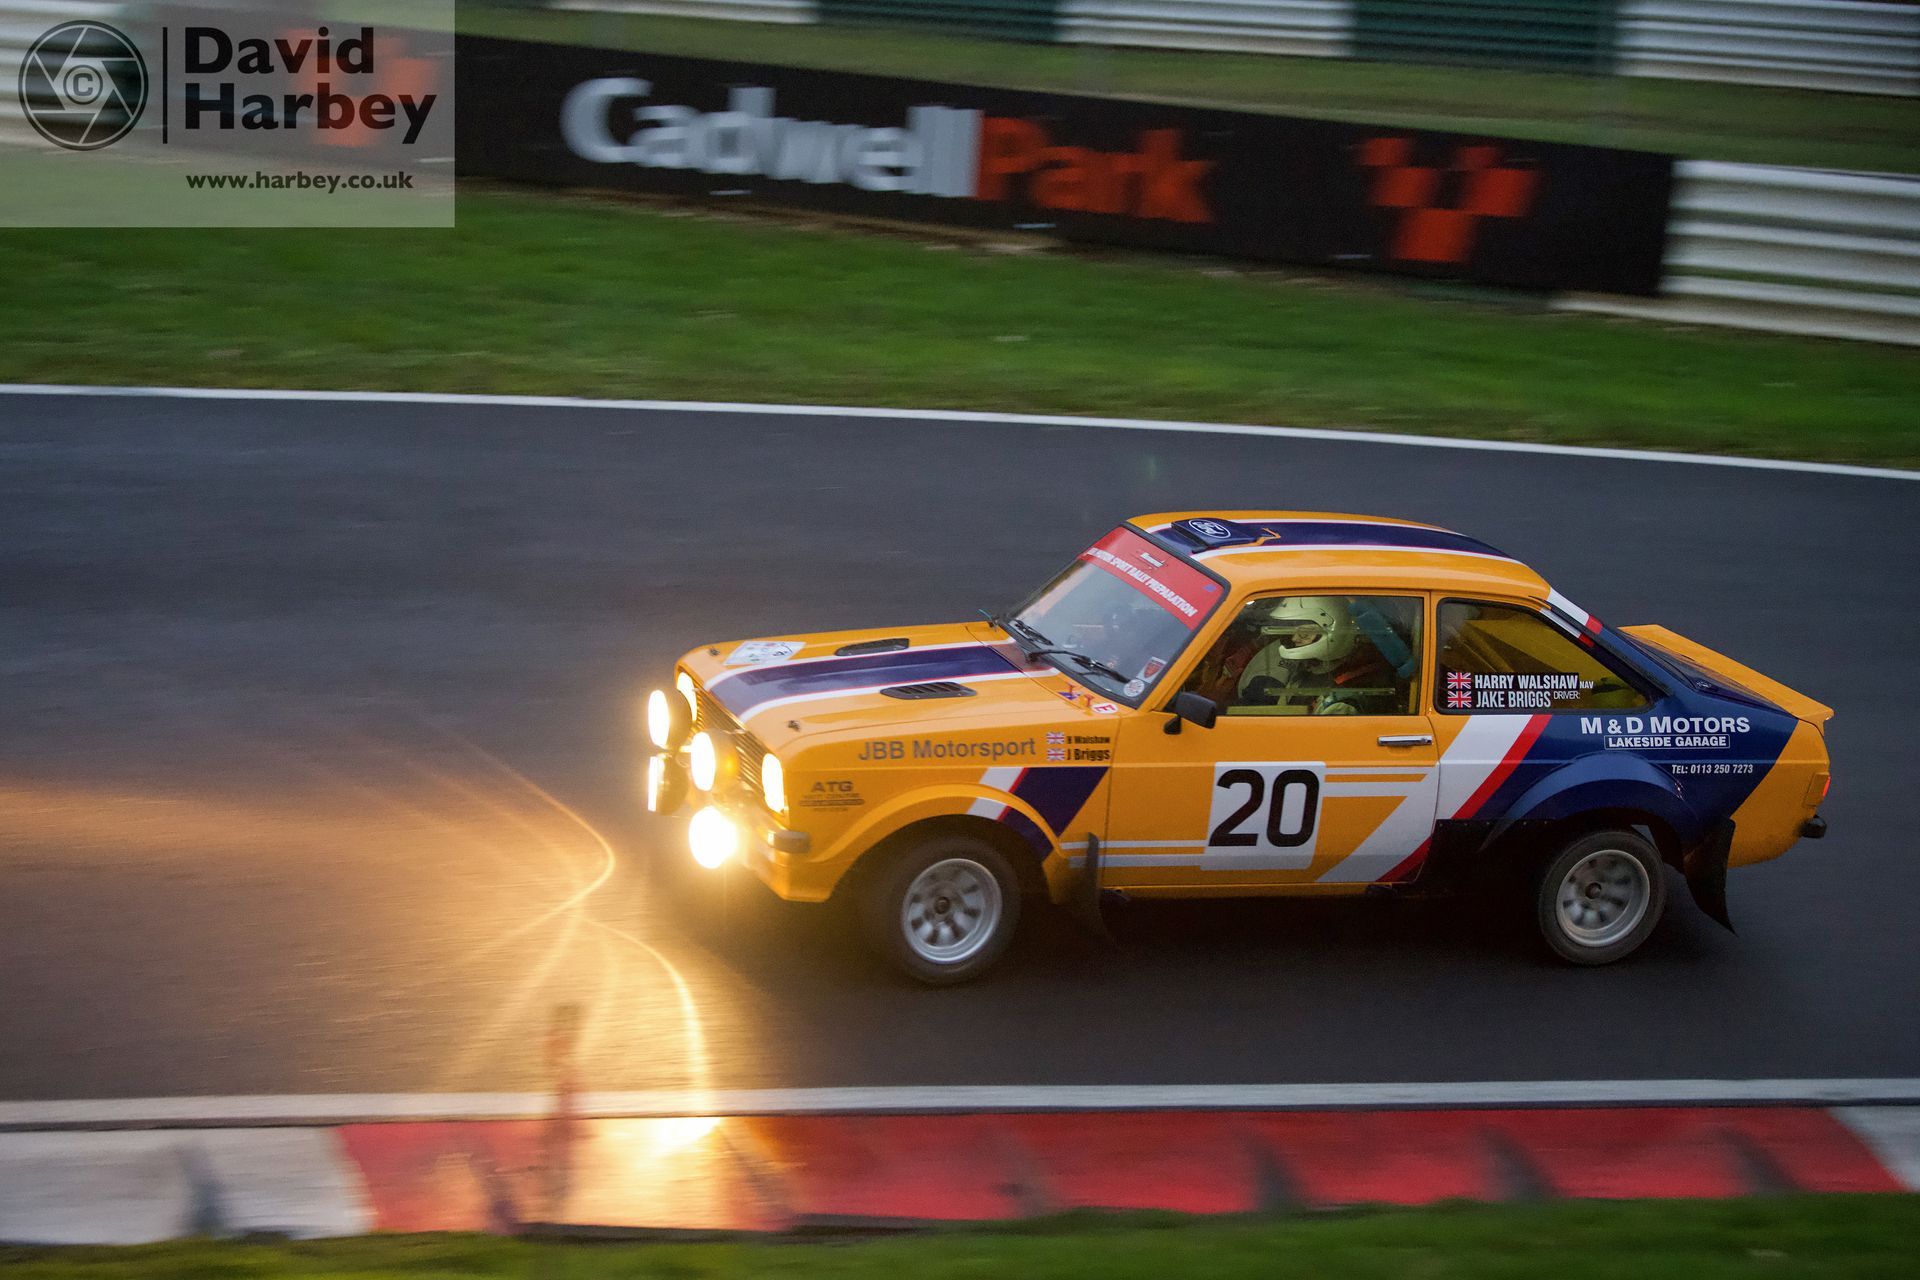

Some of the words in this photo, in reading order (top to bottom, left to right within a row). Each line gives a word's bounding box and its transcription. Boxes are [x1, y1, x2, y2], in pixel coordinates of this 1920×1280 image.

[1145, 577, 1198, 617] PREPARATION
[1474, 674, 1514, 689] HARRY
[1518, 674, 1578, 689] WALSHAW
[1579, 681, 1594, 689] NAV
[1475, 690, 1505, 708] JAKE
[1508, 691, 1551, 708] BRIGGS
[1580, 717, 1603, 734] M
[1607, 718, 1622, 734] &
[1625, 717, 1644, 733] D
[1650, 716, 1751, 734] MOTORS
[858, 741, 905, 760] JBB
[913, 738, 1036, 761] Motorsport
[1608, 737, 1671, 748] LAKESIDE
[1675, 736, 1727, 747] GARAGE
[1690, 764, 1712, 774] 0113
[1713, 764, 1730, 774] 250
[1732, 764, 1753, 774] 7273
[811, 780, 854, 793] ATG
[1208, 769, 1320, 847] 20
